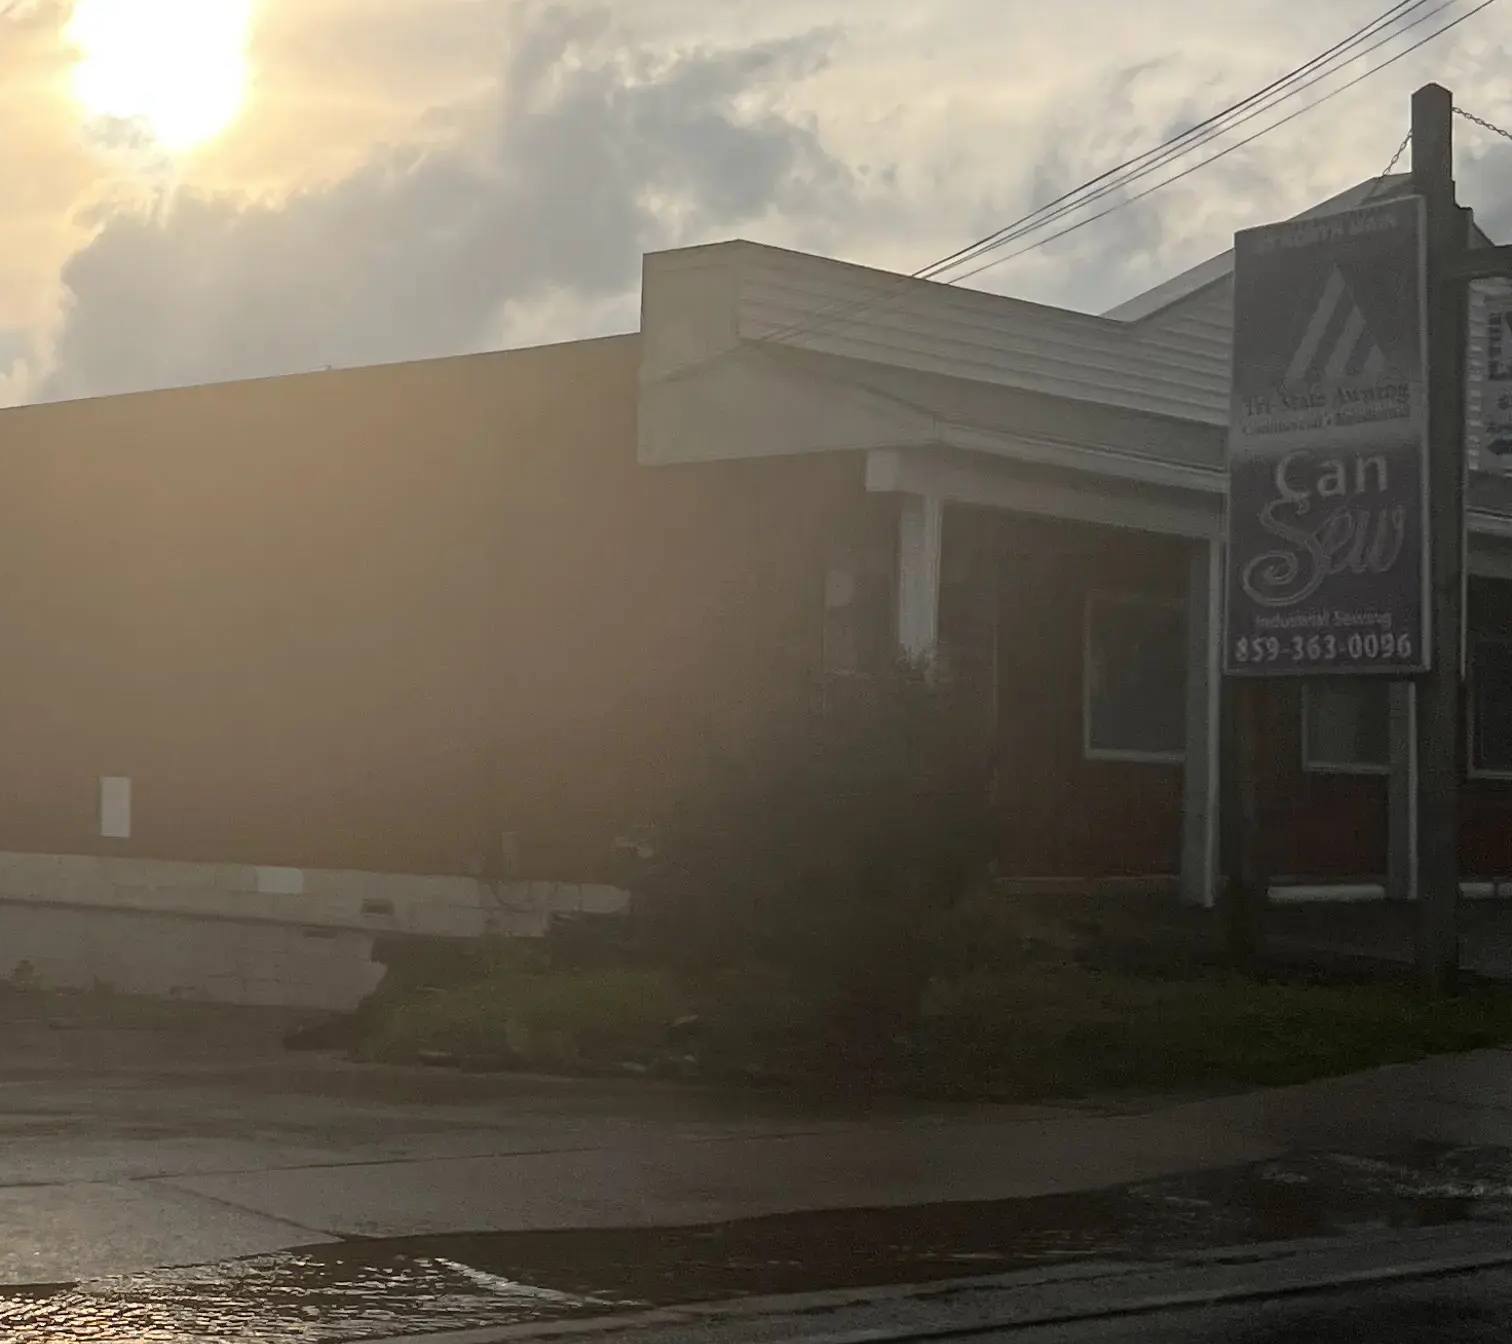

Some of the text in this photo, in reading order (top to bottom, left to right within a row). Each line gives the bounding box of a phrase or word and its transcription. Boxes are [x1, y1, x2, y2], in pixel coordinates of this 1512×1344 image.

[1276, 450, 1387, 497] Can
[1243, 498, 1406, 607] Sew
[1235, 632, 1412, 662] 859-363-0096
